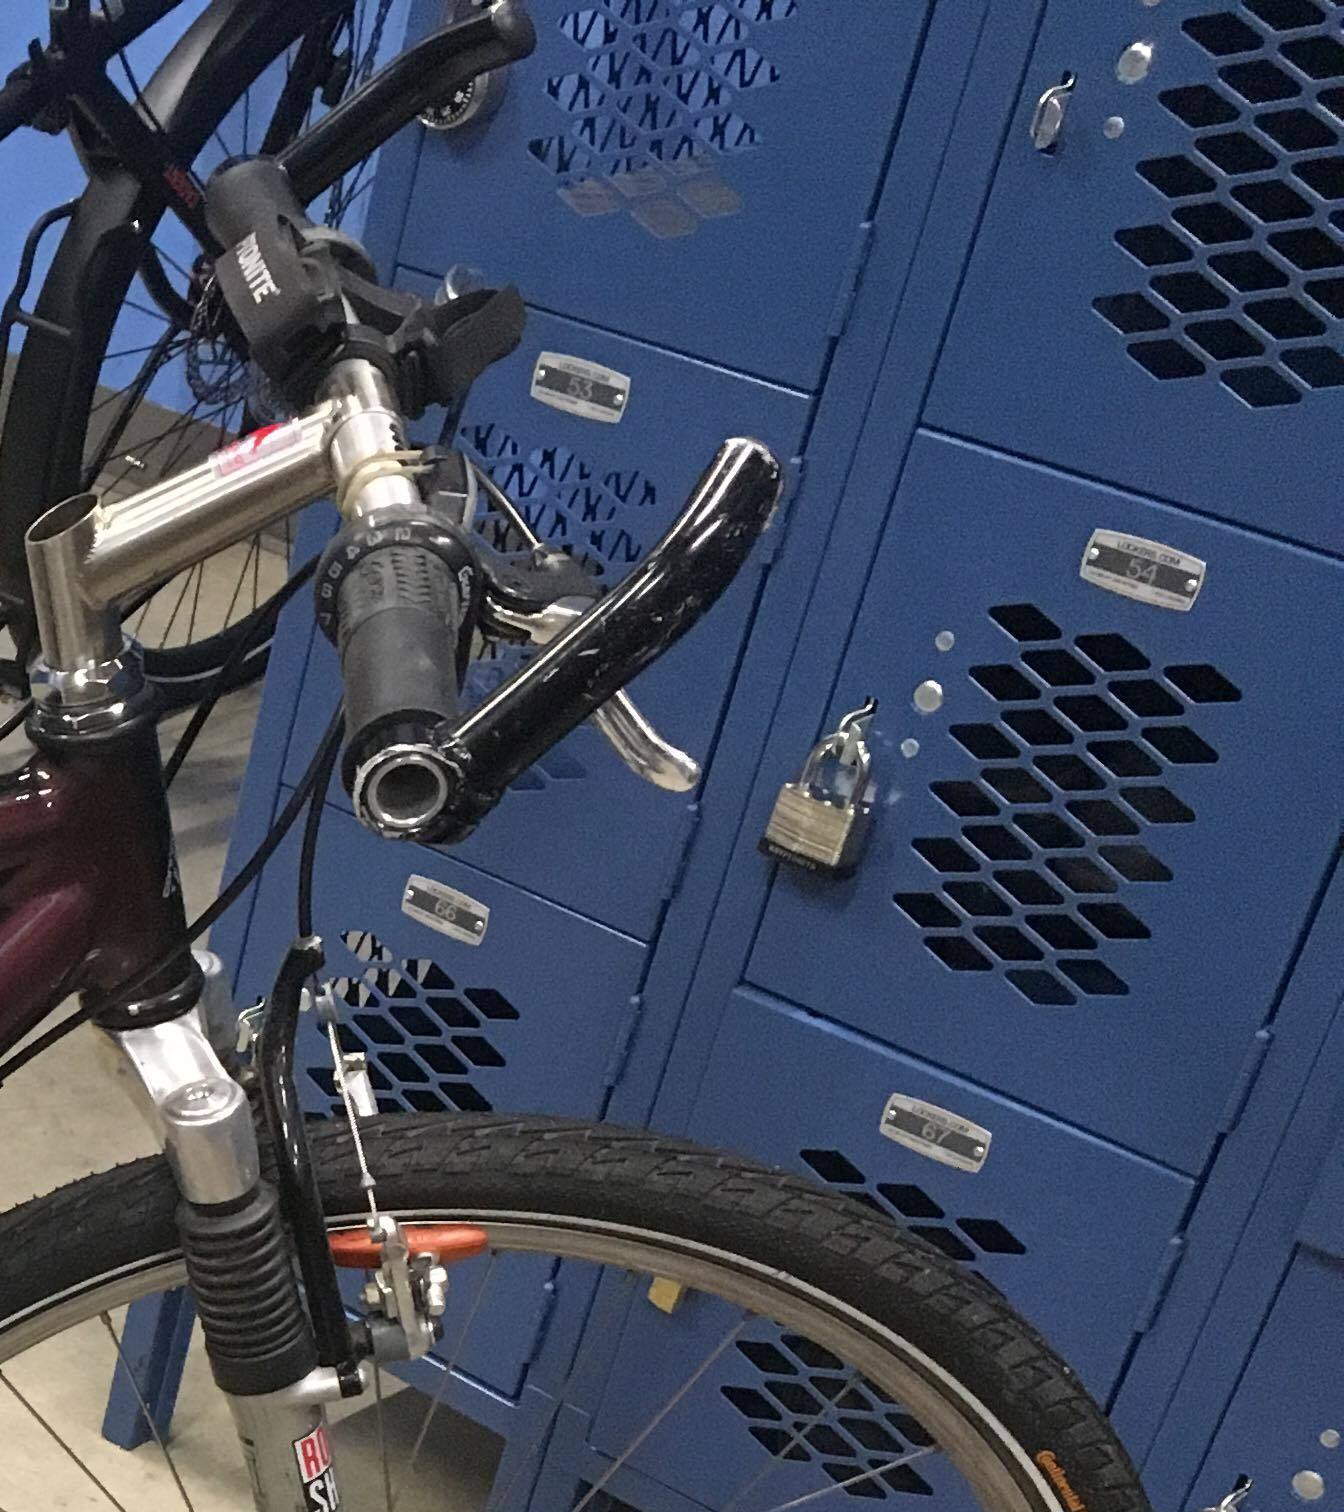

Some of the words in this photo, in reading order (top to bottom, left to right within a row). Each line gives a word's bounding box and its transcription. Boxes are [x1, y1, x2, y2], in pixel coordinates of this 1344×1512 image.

[568, 377, 593, 400] 53
[1126, 557, 1158, 585] 54
[434, 898, 457, 921] 66
[921, 1121, 953, 1145] 67
